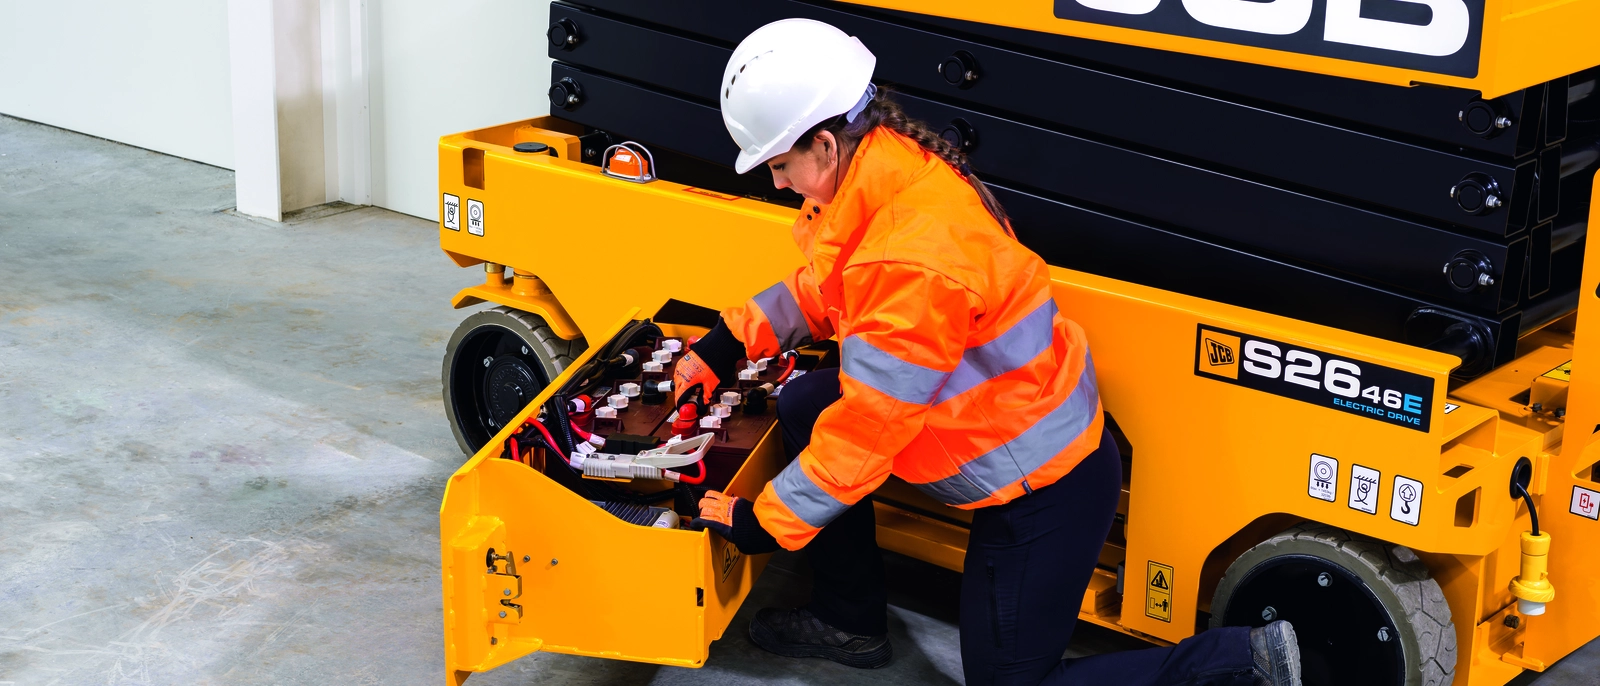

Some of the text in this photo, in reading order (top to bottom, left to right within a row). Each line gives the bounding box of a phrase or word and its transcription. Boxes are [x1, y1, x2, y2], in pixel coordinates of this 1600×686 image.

[1210, 341, 1233, 364] JCB
[1333, 397, 1421, 426] ELECTRIC DRIVE
